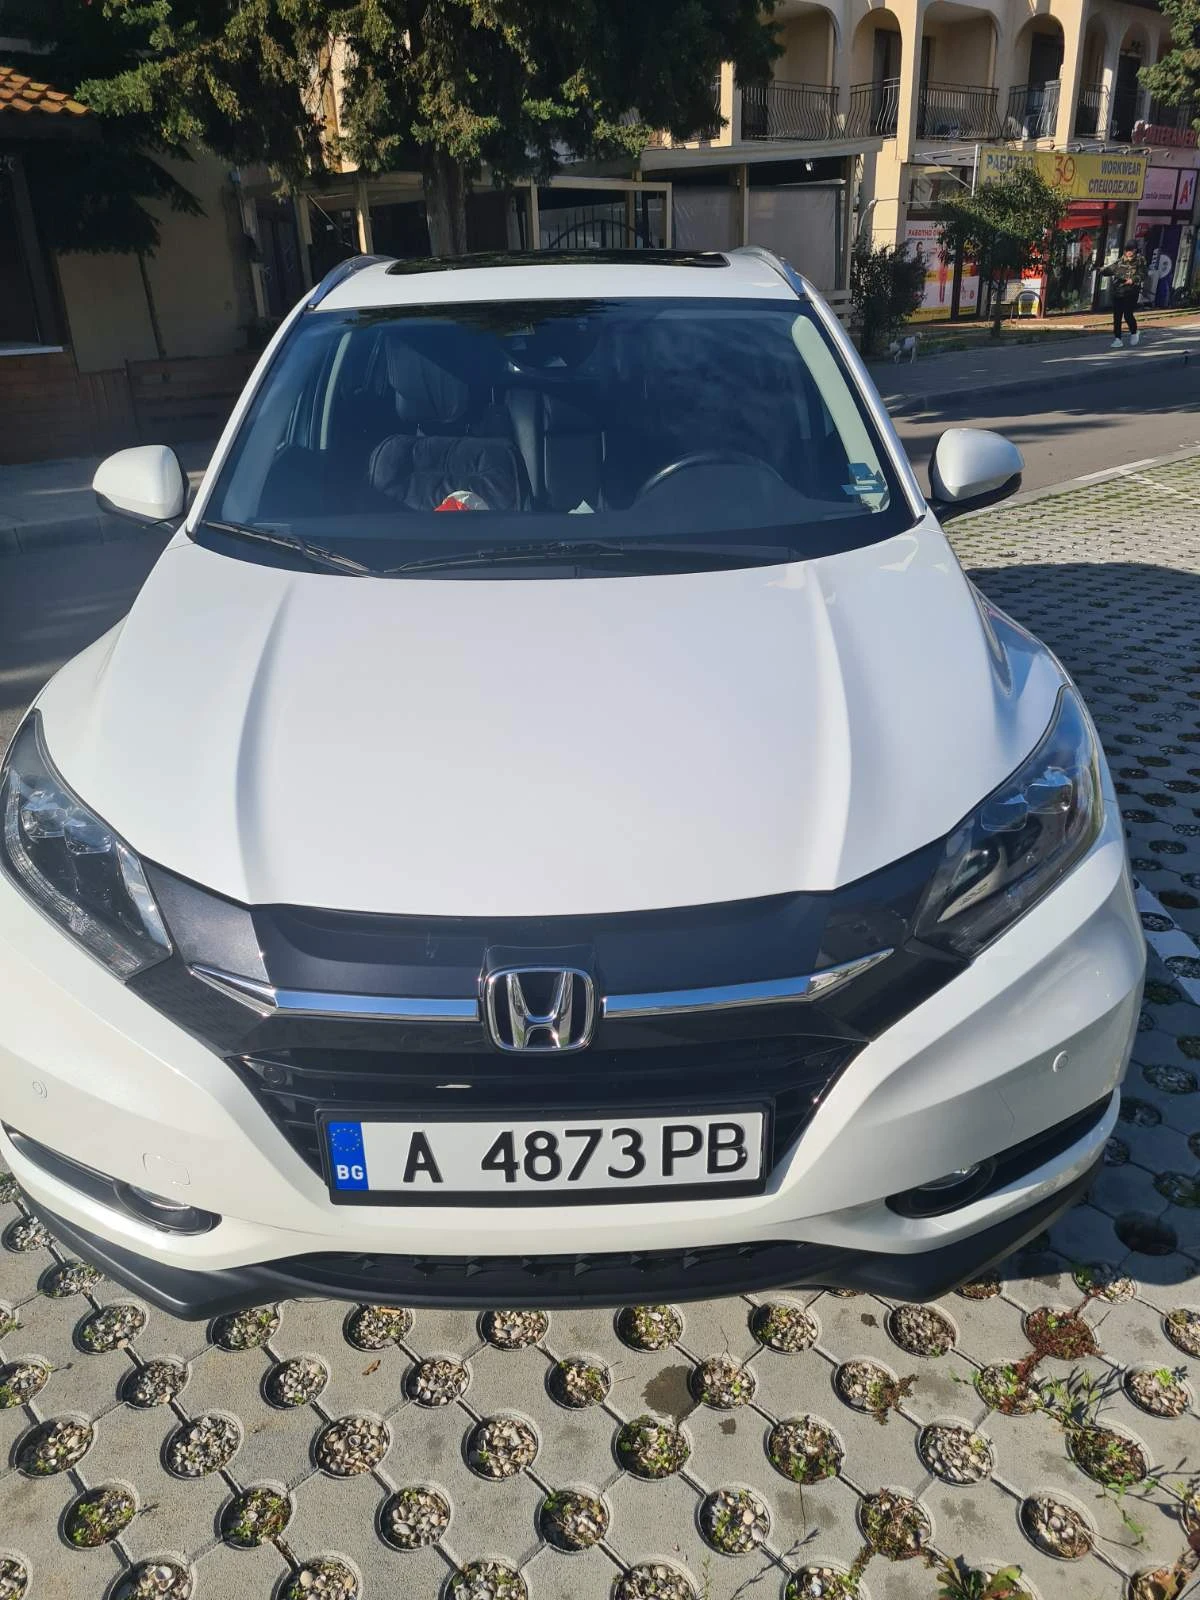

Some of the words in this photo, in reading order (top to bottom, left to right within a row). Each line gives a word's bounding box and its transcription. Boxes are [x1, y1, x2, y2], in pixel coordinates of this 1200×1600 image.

[1101, 160, 1141, 176] WORKWEAR
[1088, 178, 1138, 193] СПЕЦОДЕЖДА
[402, 1131, 443, 1183] A
[480, 1127, 645, 1183] 4873
[661, 1121, 747, 1177] PB
[336, 1164, 364, 1180] BG
